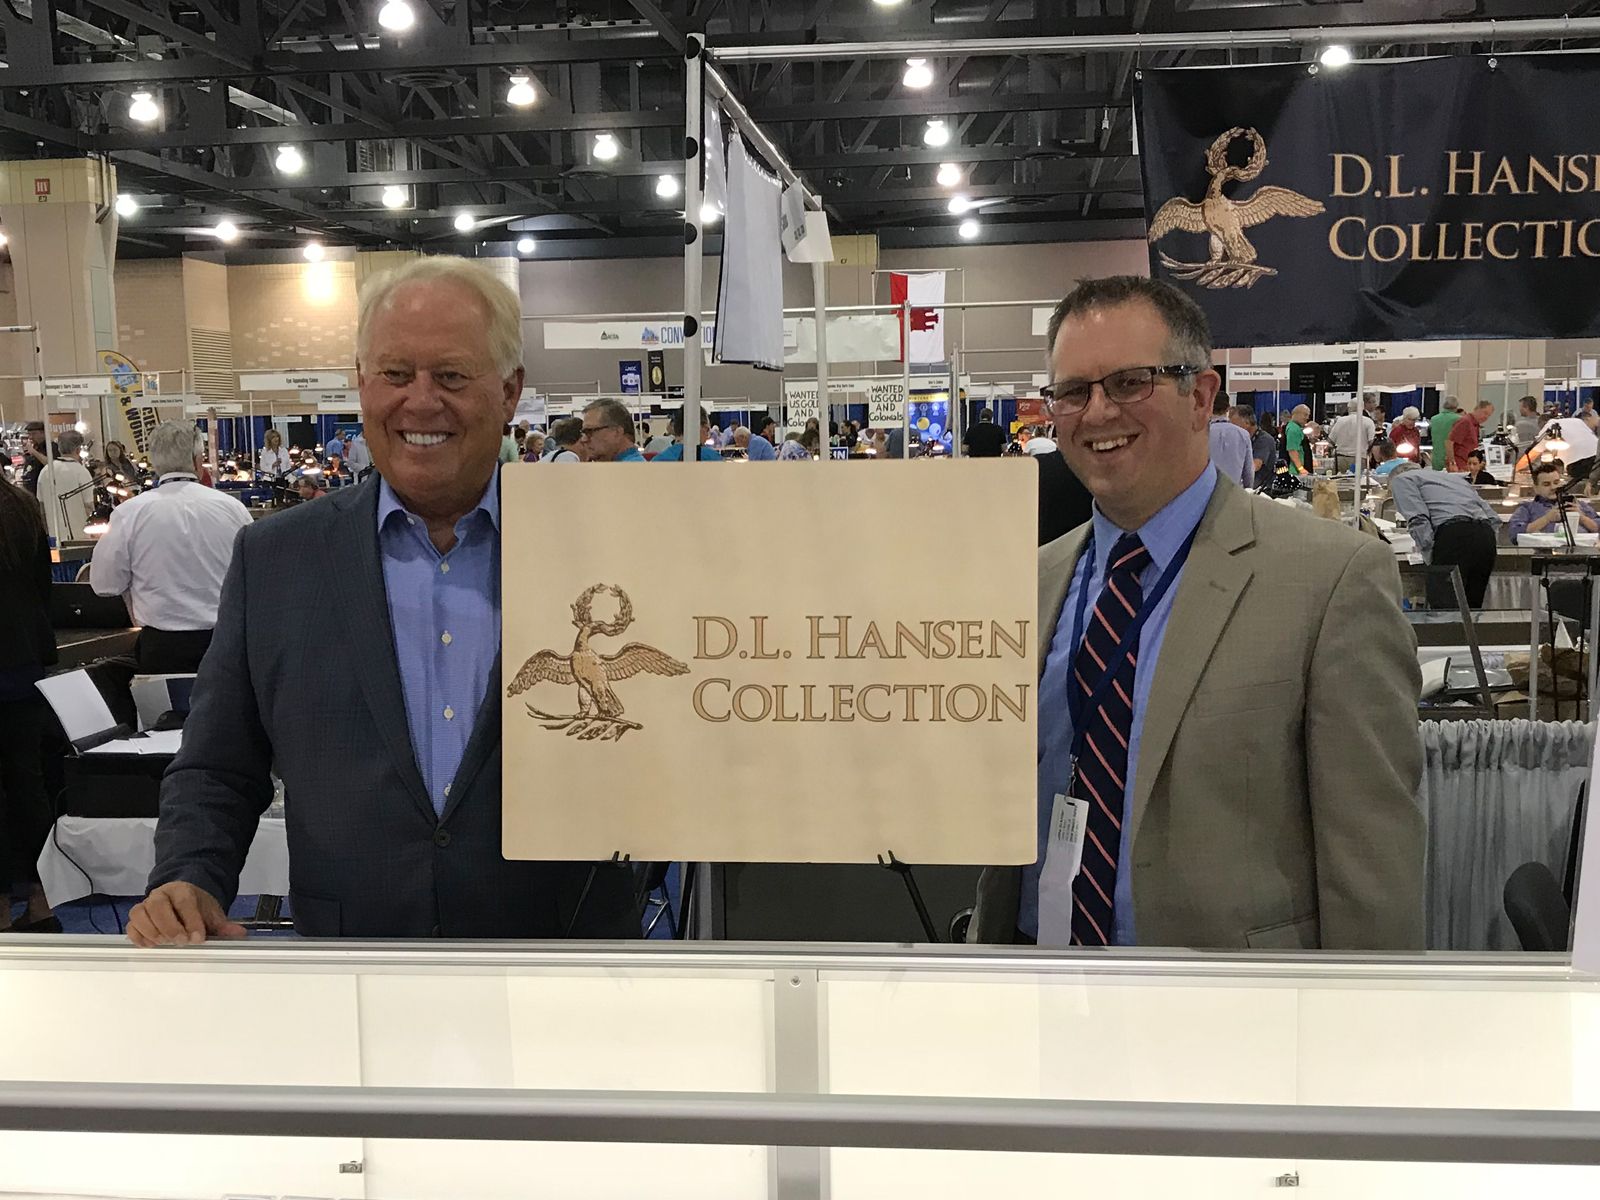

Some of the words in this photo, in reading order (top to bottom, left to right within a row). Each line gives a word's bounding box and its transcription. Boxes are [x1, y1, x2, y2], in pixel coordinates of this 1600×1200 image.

[1328, 152, 1429, 199] D.L.
[871, 384, 904, 394] WANTED
[876, 403, 896, 412] AND
[794, 409, 814, 418] AND
[868, 411, 904, 422] Colonials
[692, 616, 792, 660] D.L.
[805, 615, 1030, 660] HANSEN
[692, 678, 1030, 723] COLLECTION
